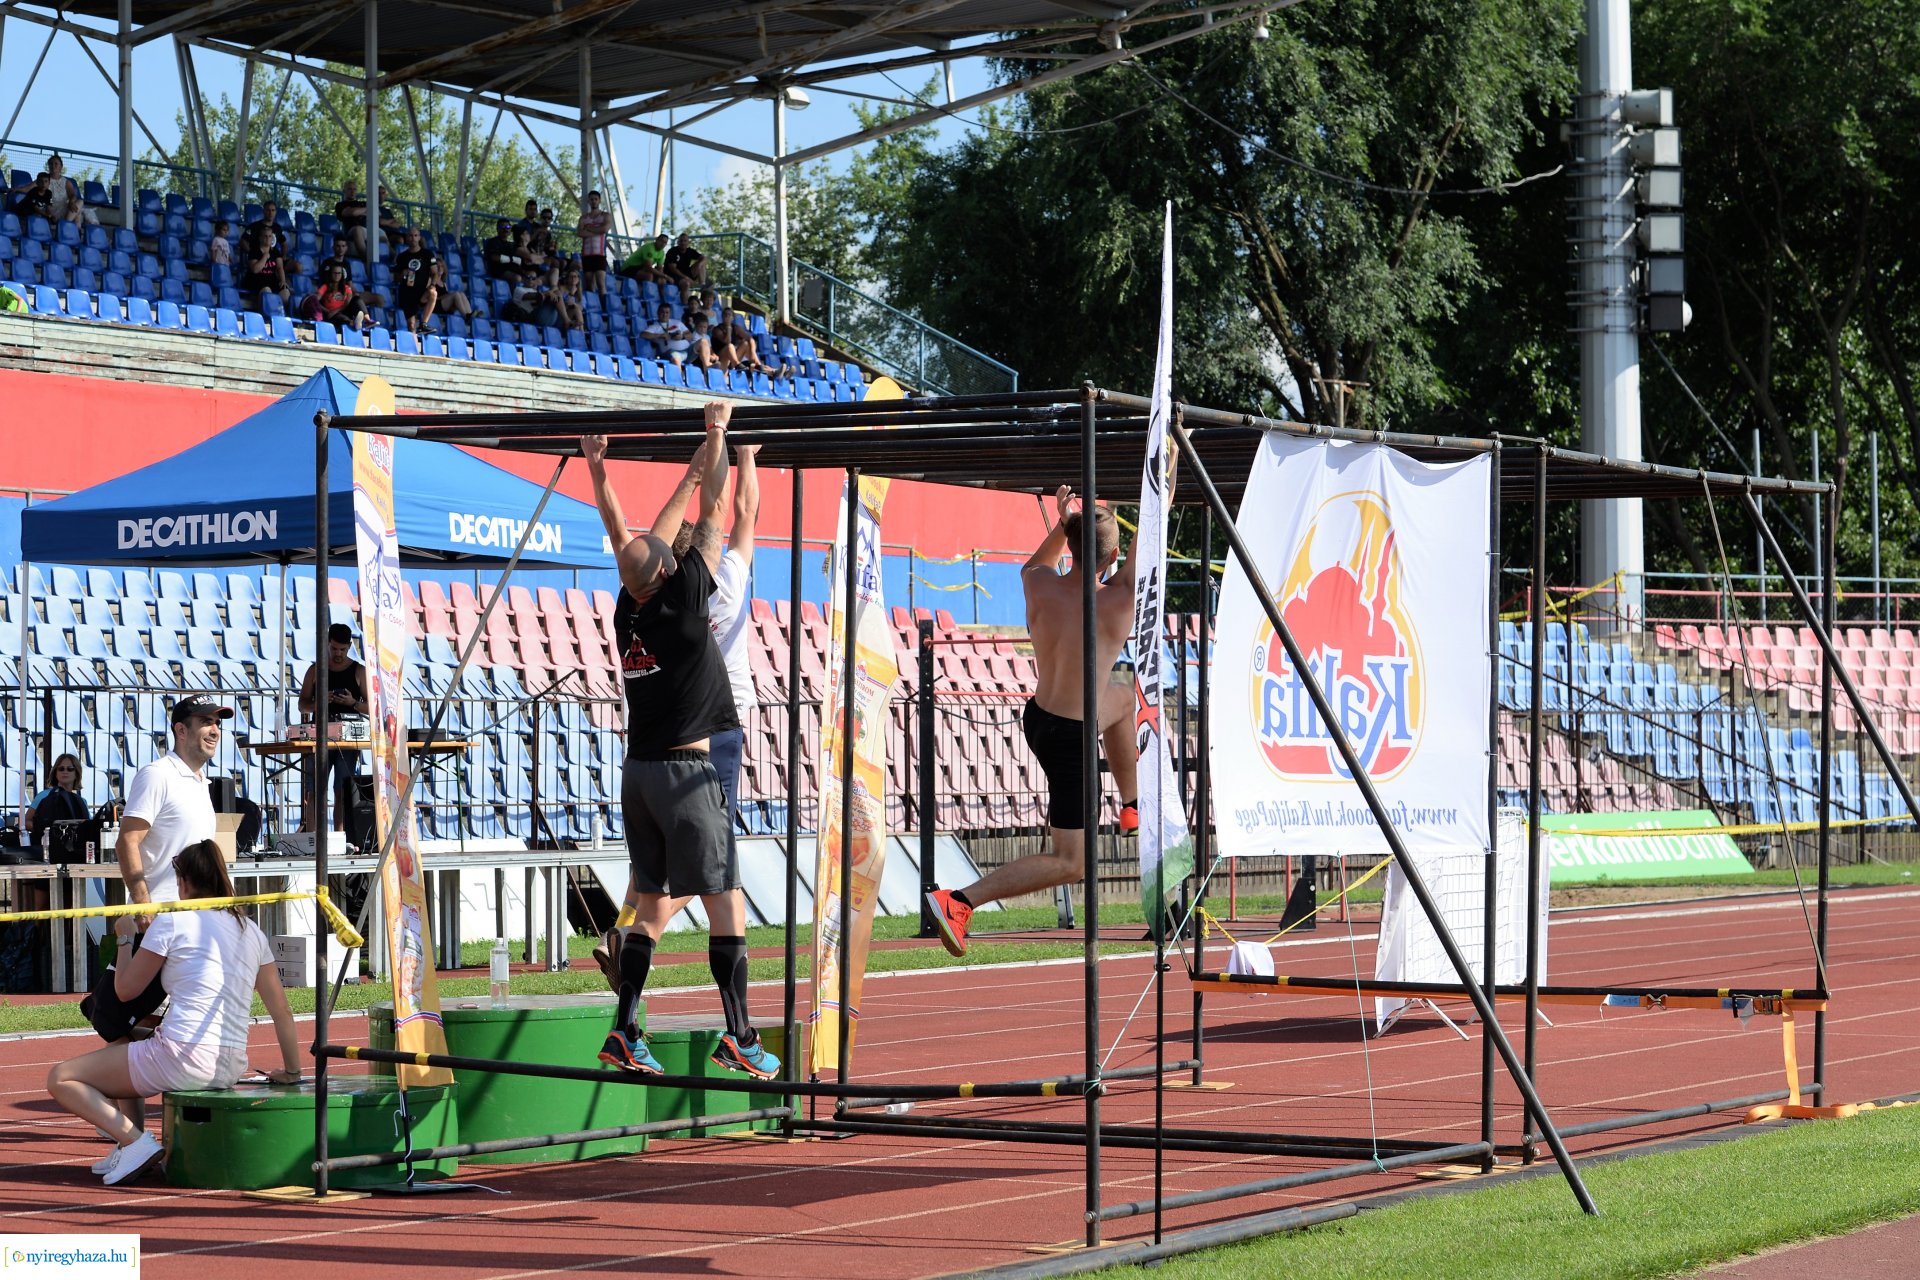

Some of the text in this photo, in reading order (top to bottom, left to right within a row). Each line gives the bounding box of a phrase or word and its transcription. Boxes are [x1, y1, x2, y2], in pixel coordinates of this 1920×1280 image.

[117, 509, 277, 550] DECATHLON
[448, 511, 563, 554] DECATHLON
[1549, 819, 1740, 868] erkantilbank
